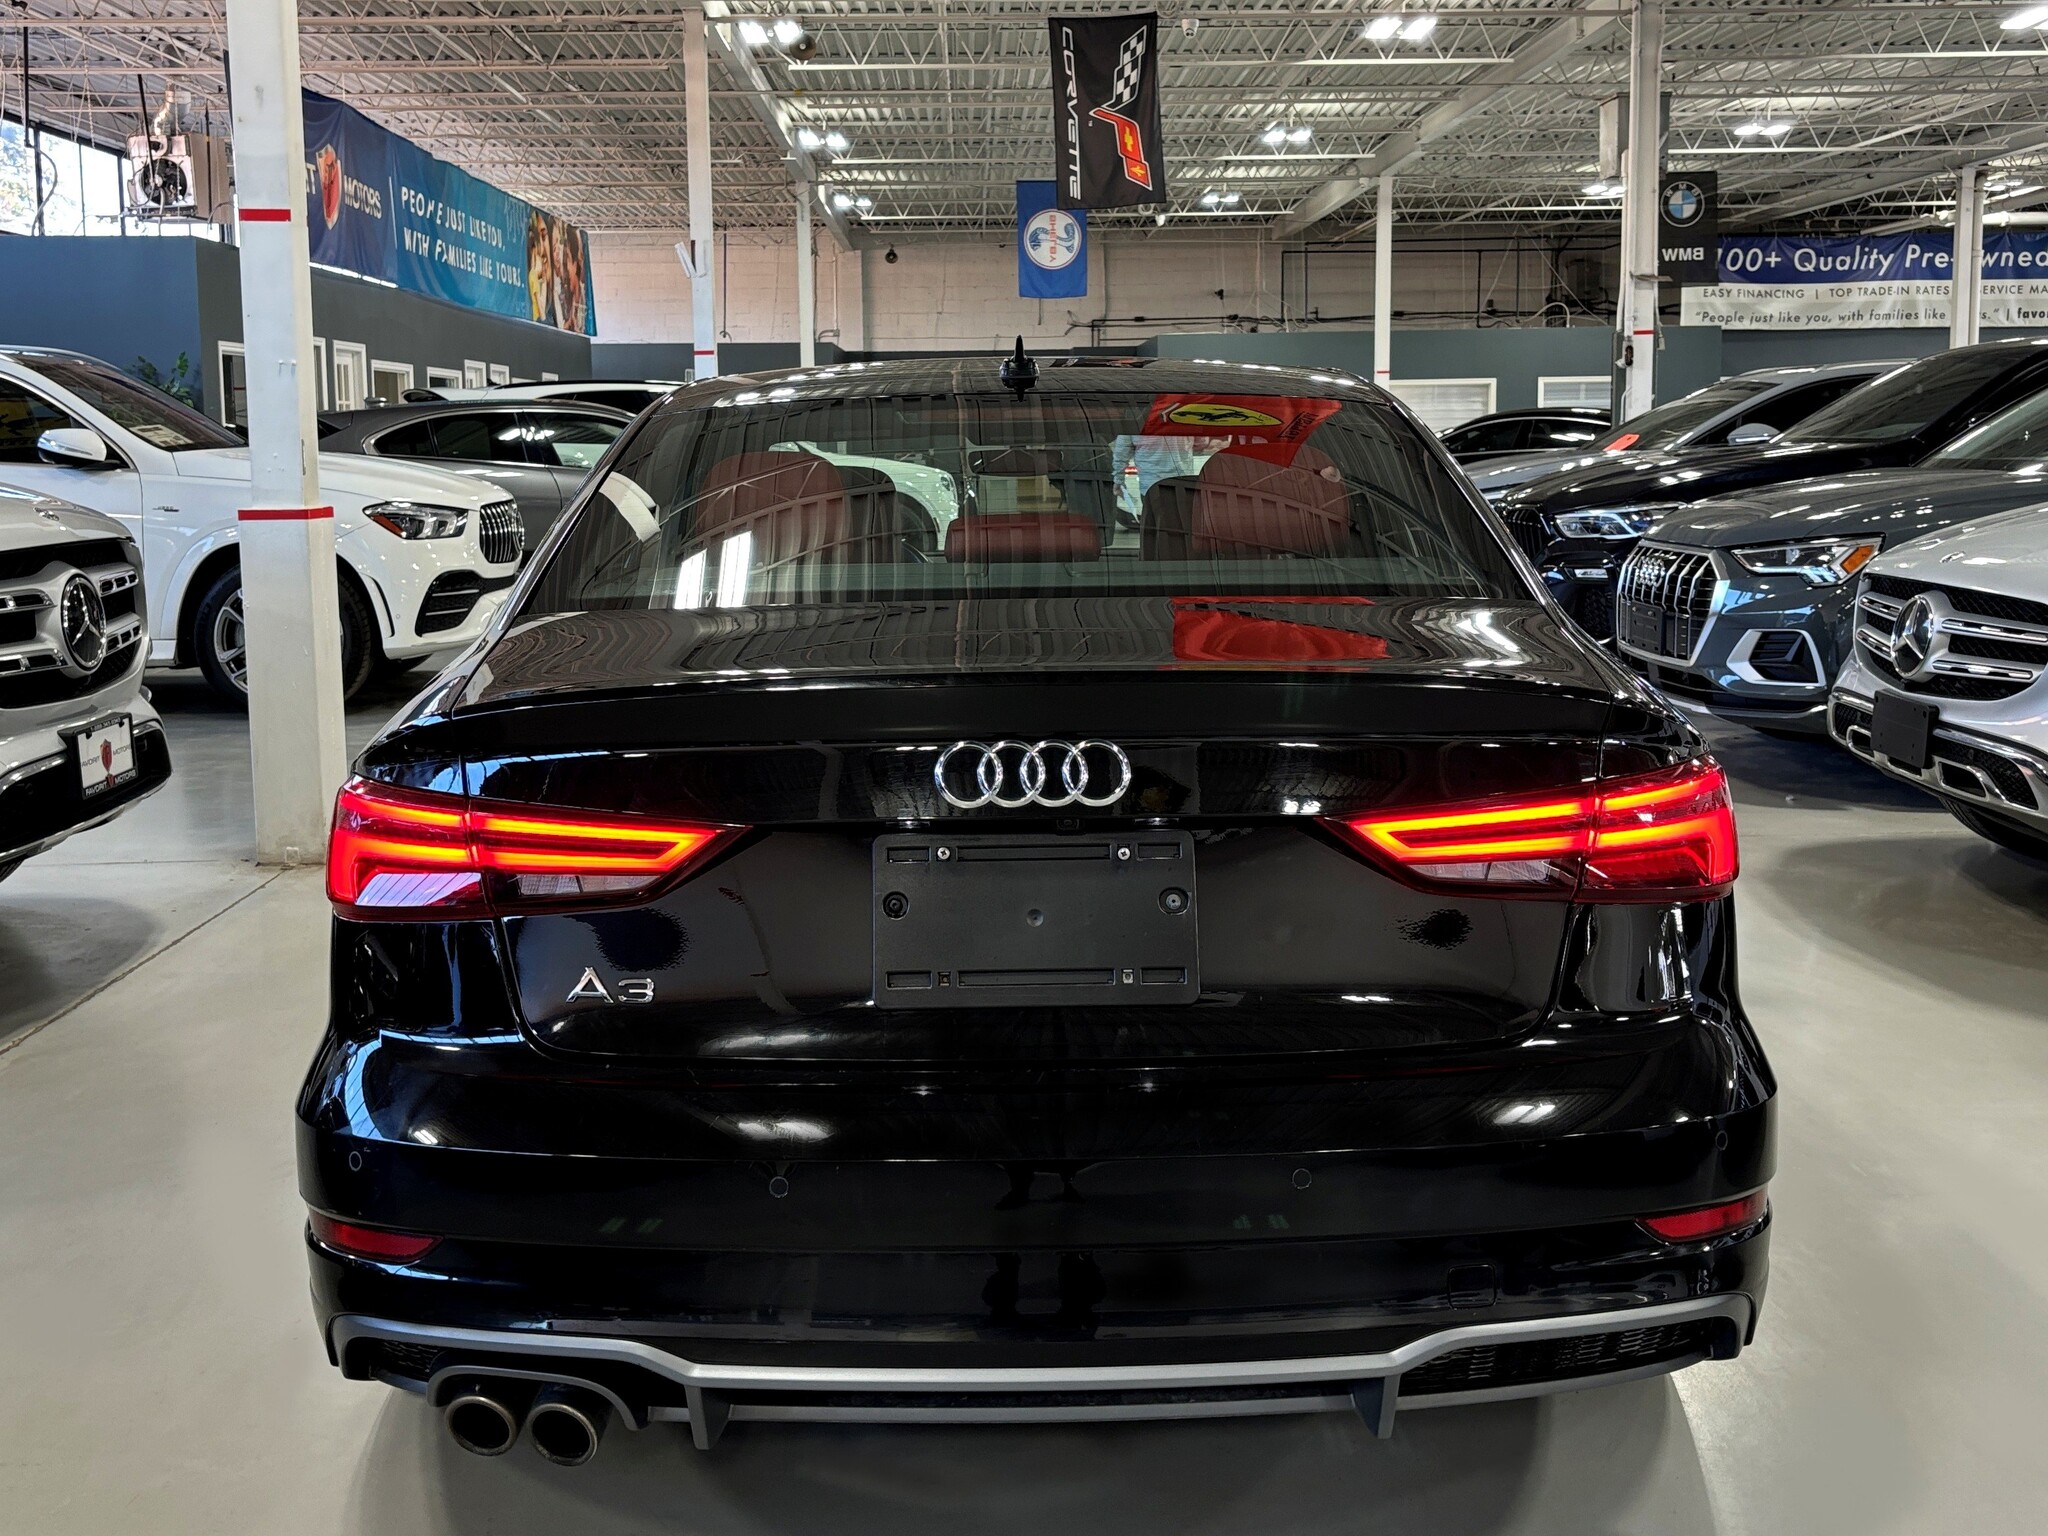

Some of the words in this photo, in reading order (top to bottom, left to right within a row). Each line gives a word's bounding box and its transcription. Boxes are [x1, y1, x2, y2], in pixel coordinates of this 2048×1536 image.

[1062, 26, 1081, 200] CORVETTE
[344, 174, 382, 219] MOTORS
[445, 206, 465, 233] JUST
[404, 227, 430, 257] WITH
[435, 239, 476, 273] FAMILIES
[1794, 245, 1894, 276] Quality
[1703, 288, 1733, 298] EASY
[1737, 288, 1805, 299] FINANCING
[1829, 288, 1853, 297] TOP
[1858, 286, 1910, 296] TRADE-IN
[1915, 285, 1950, 295] RATES
[1980, 285, 2024, 294] ERVICE
[1750, 312, 1774, 325] just
[1778, 311, 1801, 323] like
[1806, 313, 1832, 325] you,
[1838, 310, 1864, 321] with
[1869, 309, 1919, 321] families
[1924, 308, 1946, 320] like
[82, 755, 100, 767] AVORIT
[114, 769, 137, 783] MOTORS
[566, 967, 654, 1004] A3
